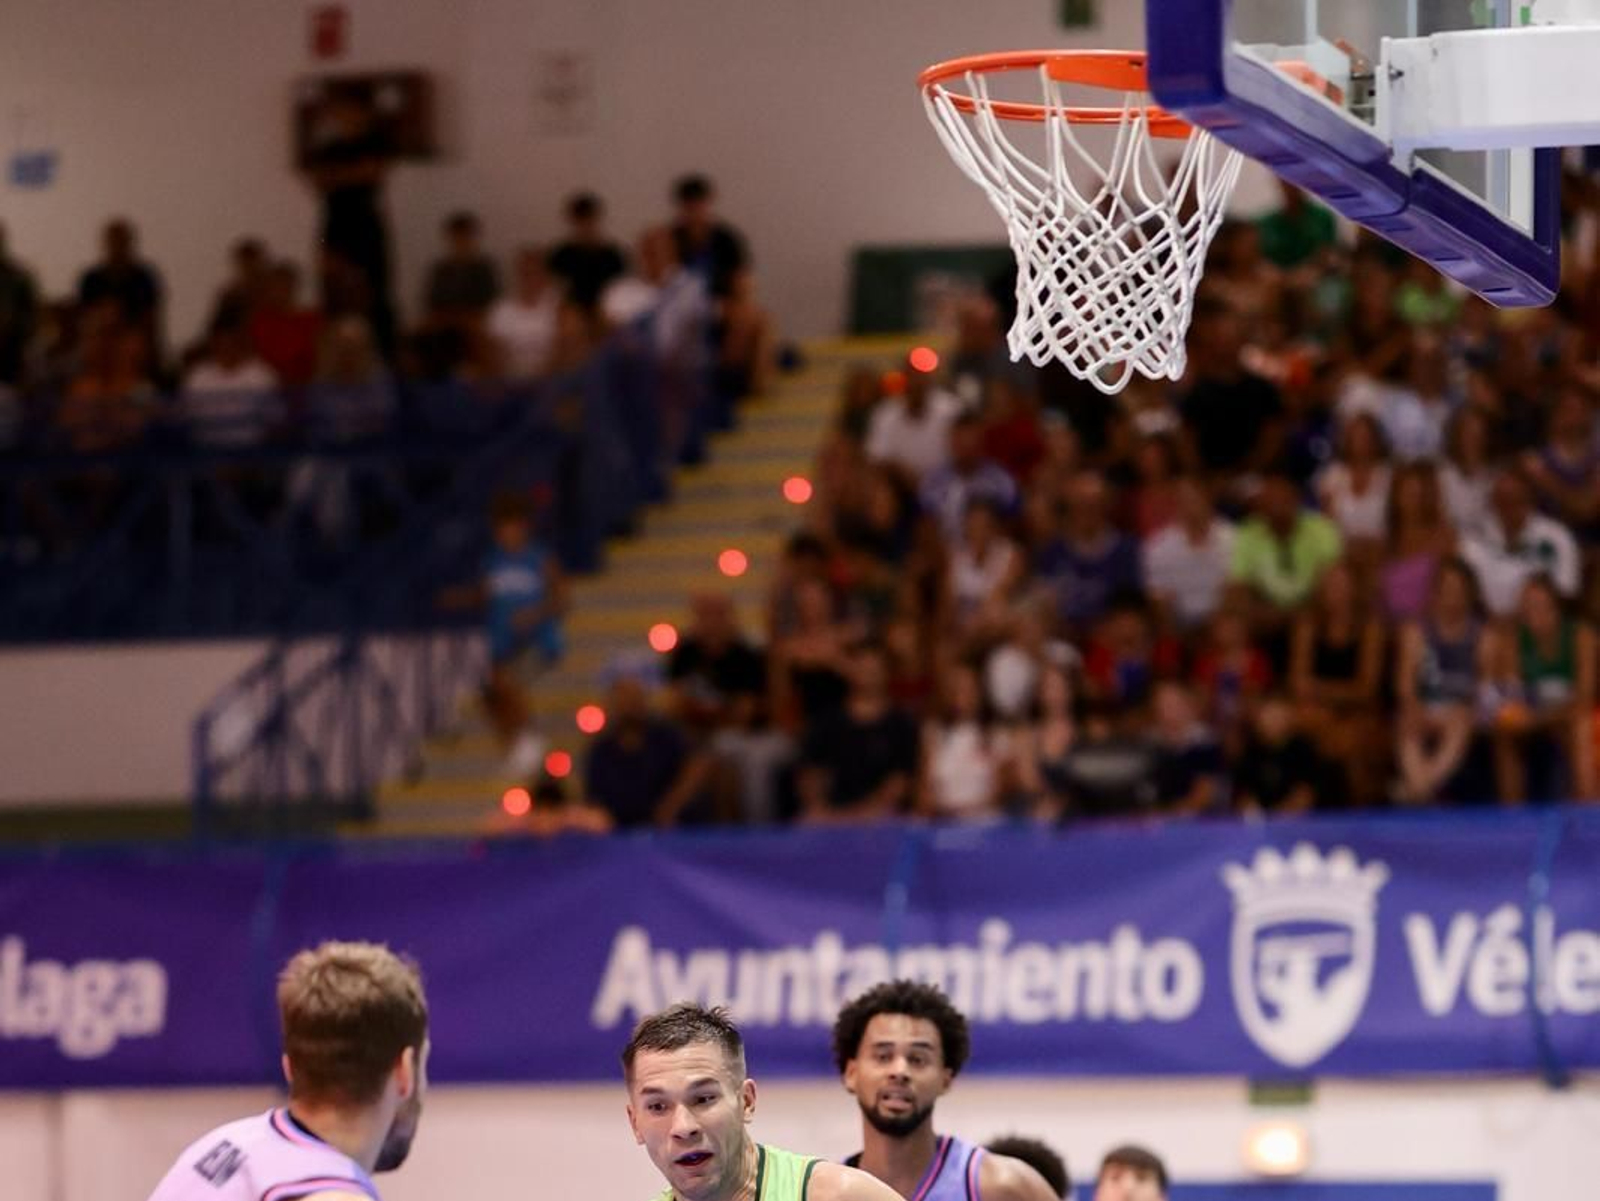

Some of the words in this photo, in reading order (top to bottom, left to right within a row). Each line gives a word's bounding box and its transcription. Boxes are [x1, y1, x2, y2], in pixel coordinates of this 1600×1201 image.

[0, 935, 167, 1060] laga
[591, 918, 1203, 1028] Ayuntamiento
[1403, 904, 1600, 1016] Véle
